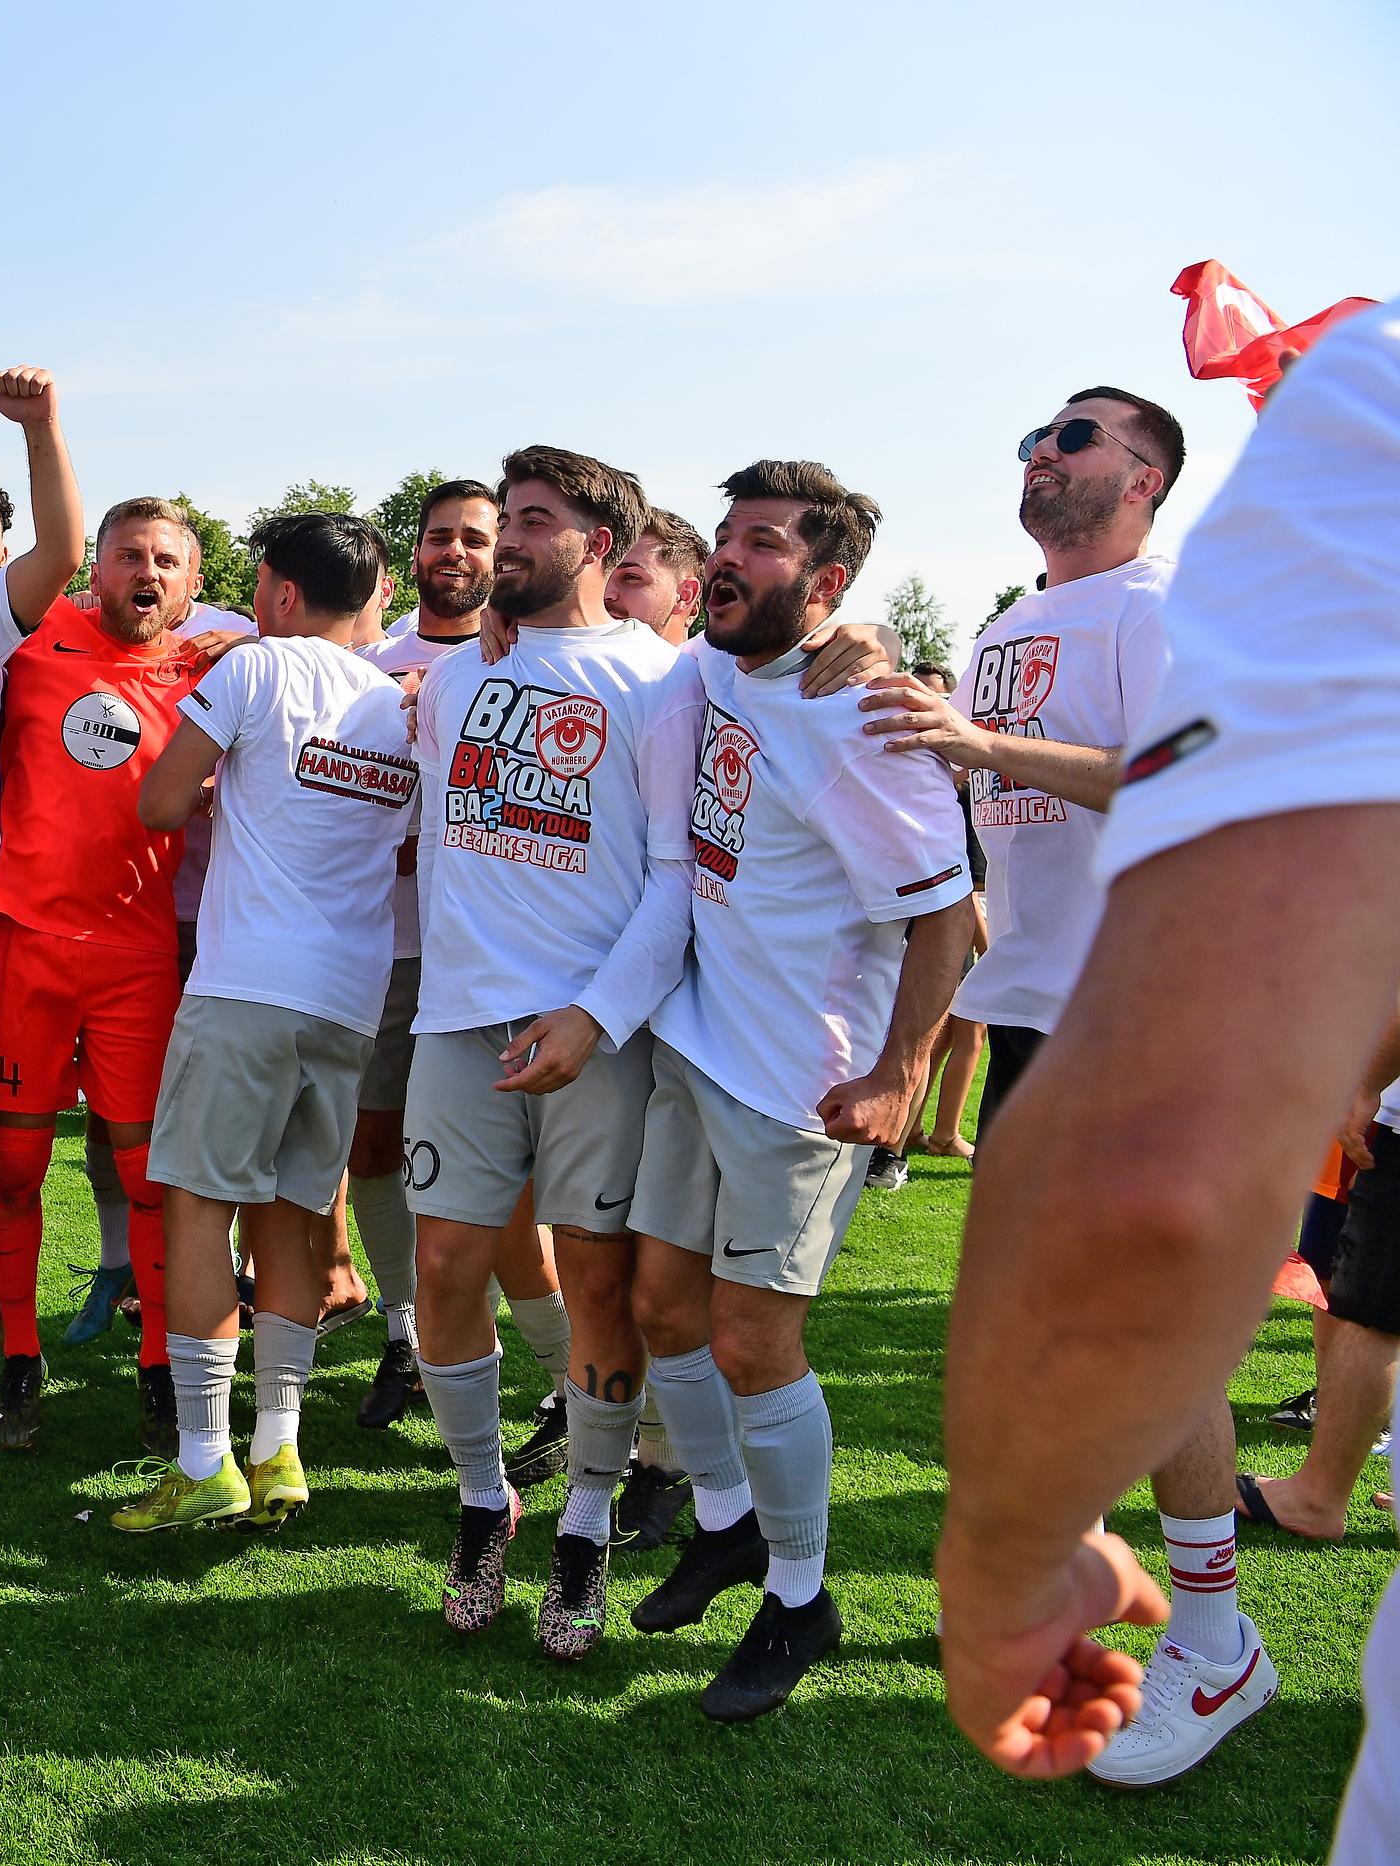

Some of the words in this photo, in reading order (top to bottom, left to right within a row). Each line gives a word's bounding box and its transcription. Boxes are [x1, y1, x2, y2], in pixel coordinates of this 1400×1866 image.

[545, 704, 598, 720] VATANSPOR
[301, 752, 360, 784] HANDY
[552, 755, 587, 765] NÜRNBERG
[495, 757, 590, 813] YOLA
[502, 804, 590, 841] KOYDUK
[445, 825, 586, 874] BEZIRKSLIGA
